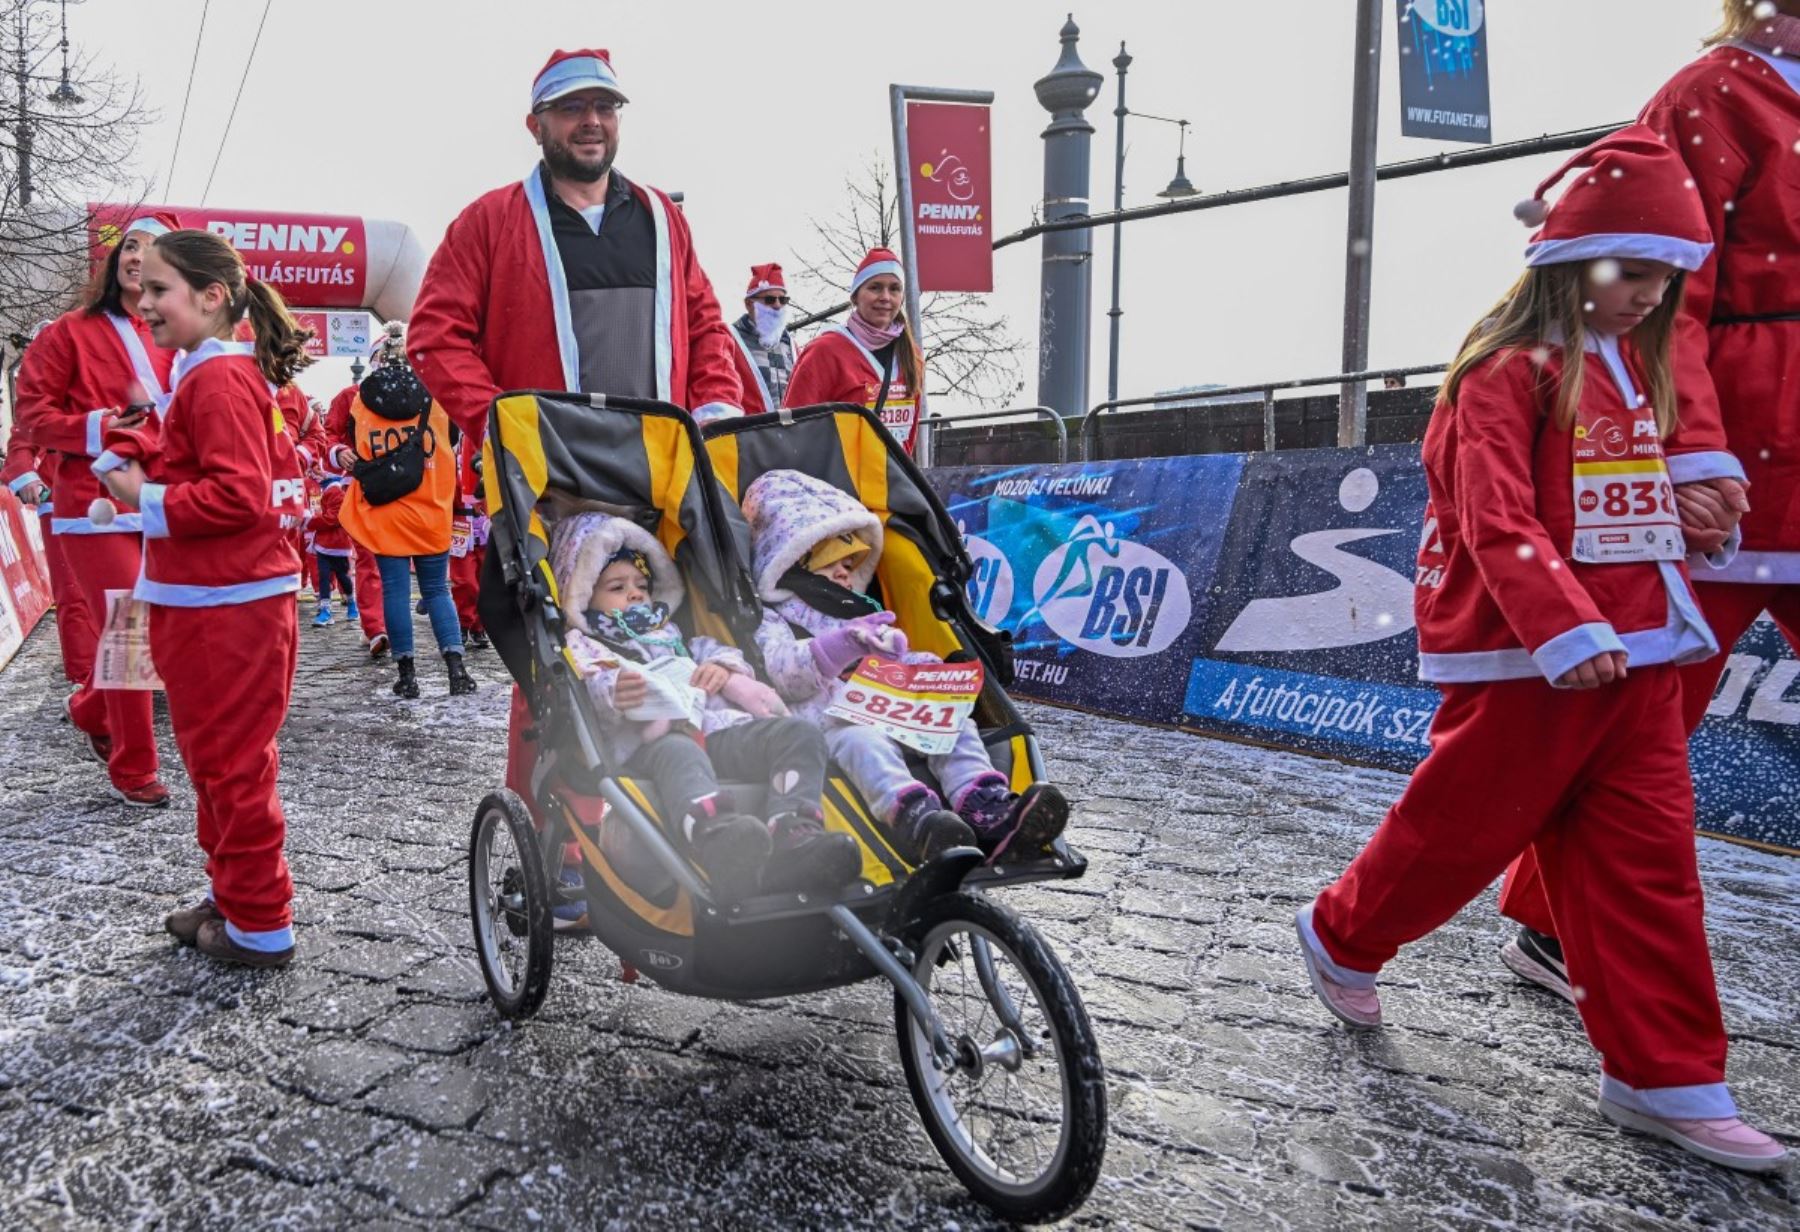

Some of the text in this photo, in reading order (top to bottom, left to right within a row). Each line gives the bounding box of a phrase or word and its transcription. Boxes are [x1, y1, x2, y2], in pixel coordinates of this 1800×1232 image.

[1407, 106, 1489, 129] WWW.FUTANET.HU
[918, 223, 983, 236] MIKULÁSFUTÁS
[993, 479, 1046, 496] MOZOGJ
[966, 556, 1002, 621] SI
[1079, 565, 1170, 648] BSI
[1012, 658, 1069, 685] NET.HU
[1214, 678, 1238, 709] A
[865, 694, 956, 728] 8241
